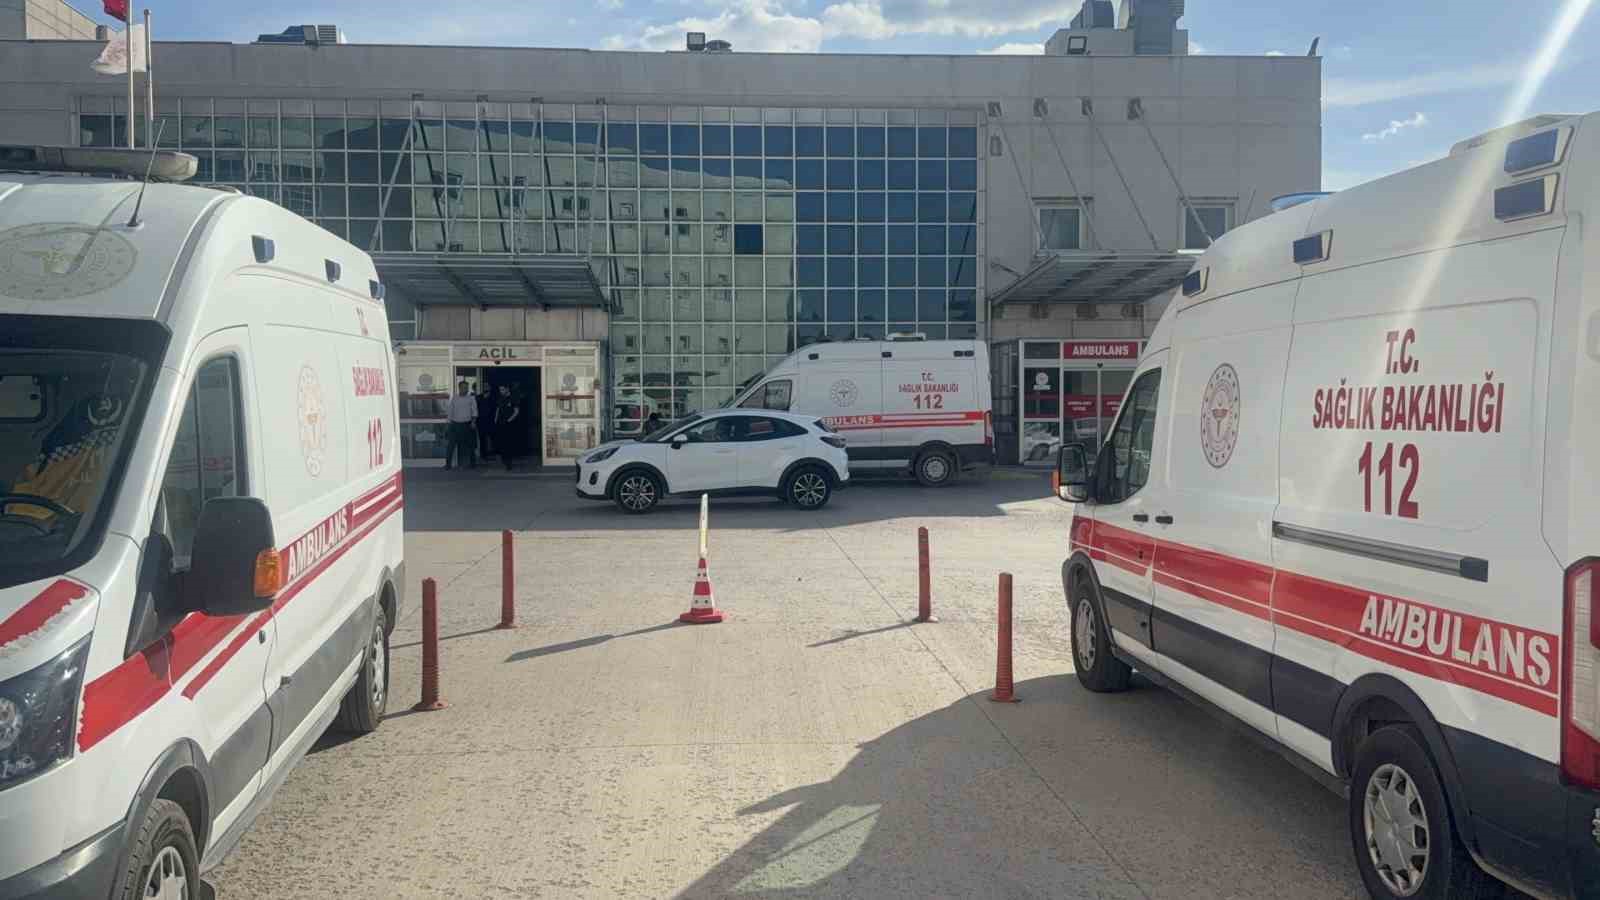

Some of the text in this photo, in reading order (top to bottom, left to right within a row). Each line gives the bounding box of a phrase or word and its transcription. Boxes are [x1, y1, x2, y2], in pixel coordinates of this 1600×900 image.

[480, 347, 517, 358] ACİL
[1072, 345, 1129, 356] AMBULANS
[1385, 328, 1419, 374] T.C.
[913, 394, 943, 409] 112
[1312, 371, 1505, 433] SAĞLIK BAKANLIĞI
[367, 416, 384, 469] 112
[1358, 441, 1420, 519] 112
[287, 508, 349, 583] AMBULANS
[1359, 594, 1552, 687] AMBULANS
